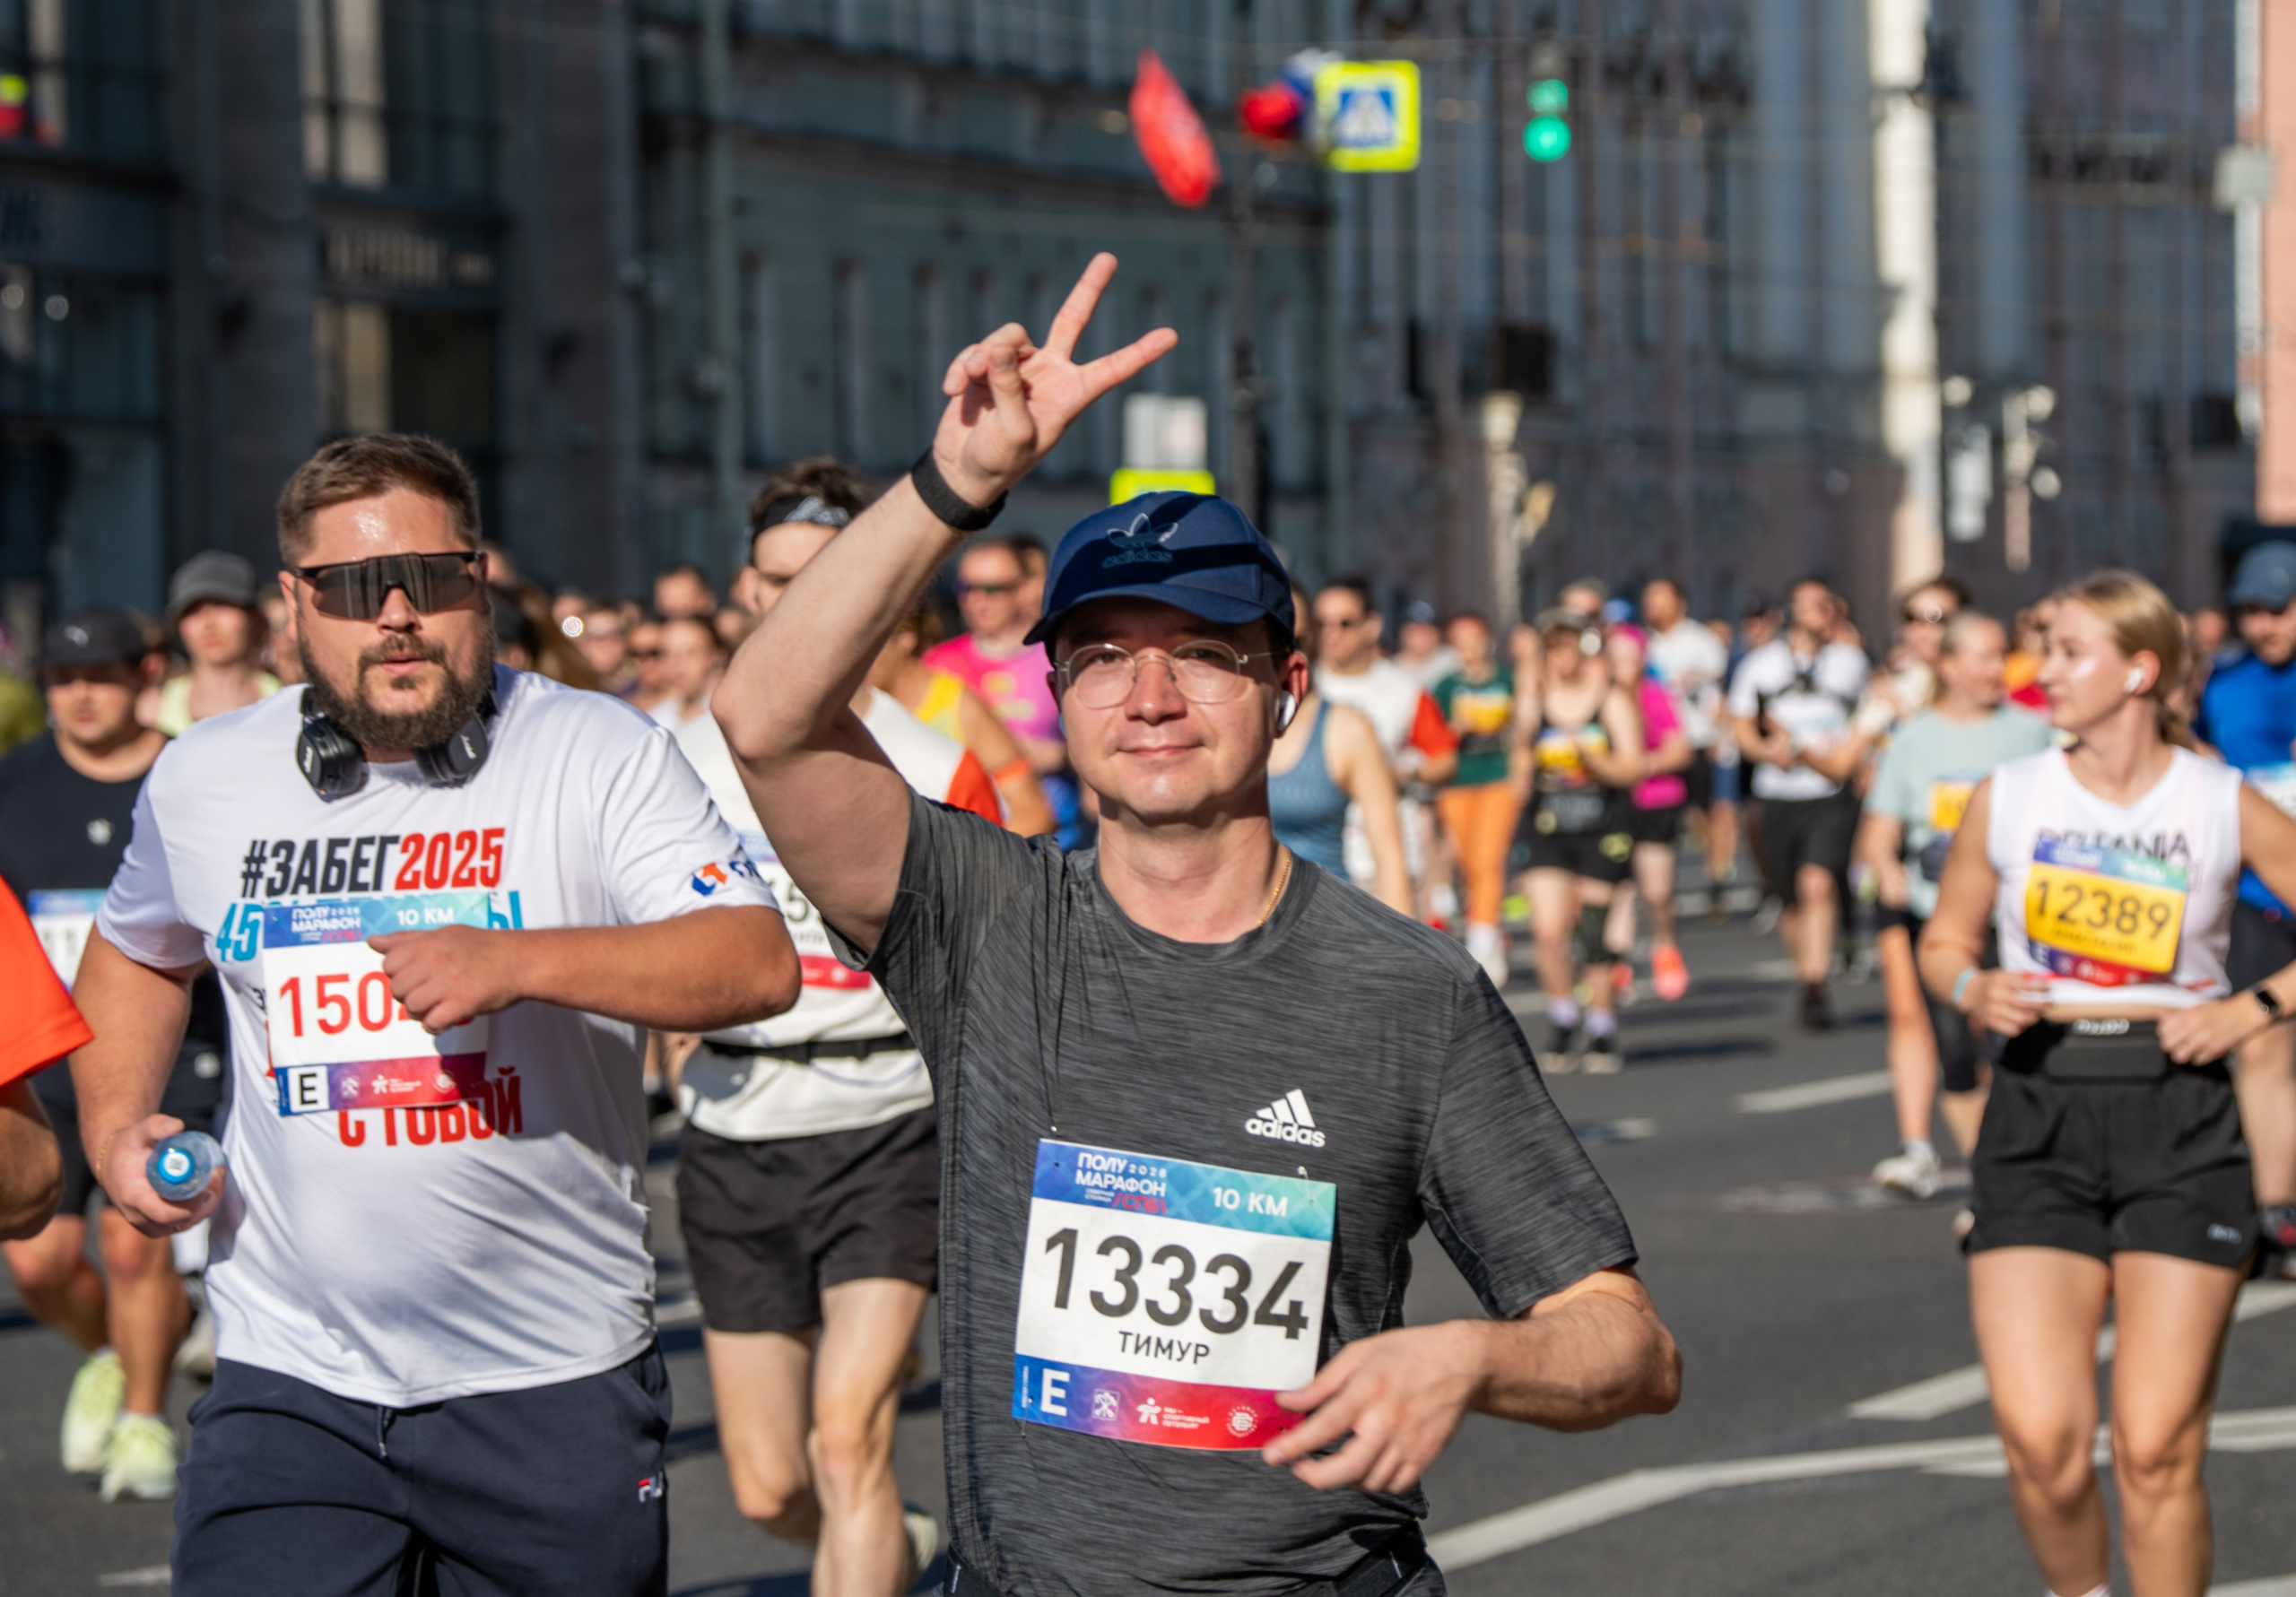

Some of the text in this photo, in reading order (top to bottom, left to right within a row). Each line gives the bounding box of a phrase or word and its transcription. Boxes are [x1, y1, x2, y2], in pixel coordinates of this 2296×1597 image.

[241, 828, 505, 898] #ЗАБЕГ2025
[2036, 879, 2171, 939] 12389
[1244, 1118, 1326, 1148] adidas
[1077, 1152, 1128, 1174] ПОЛУ
[1075, 1169, 1166, 1197] МАРАФОН
[1213, 1186, 1240, 1210] 10
[1045, 1228, 1309, 1341] 13334
[1118, 1331, 1211, 1365] ТИМУР
